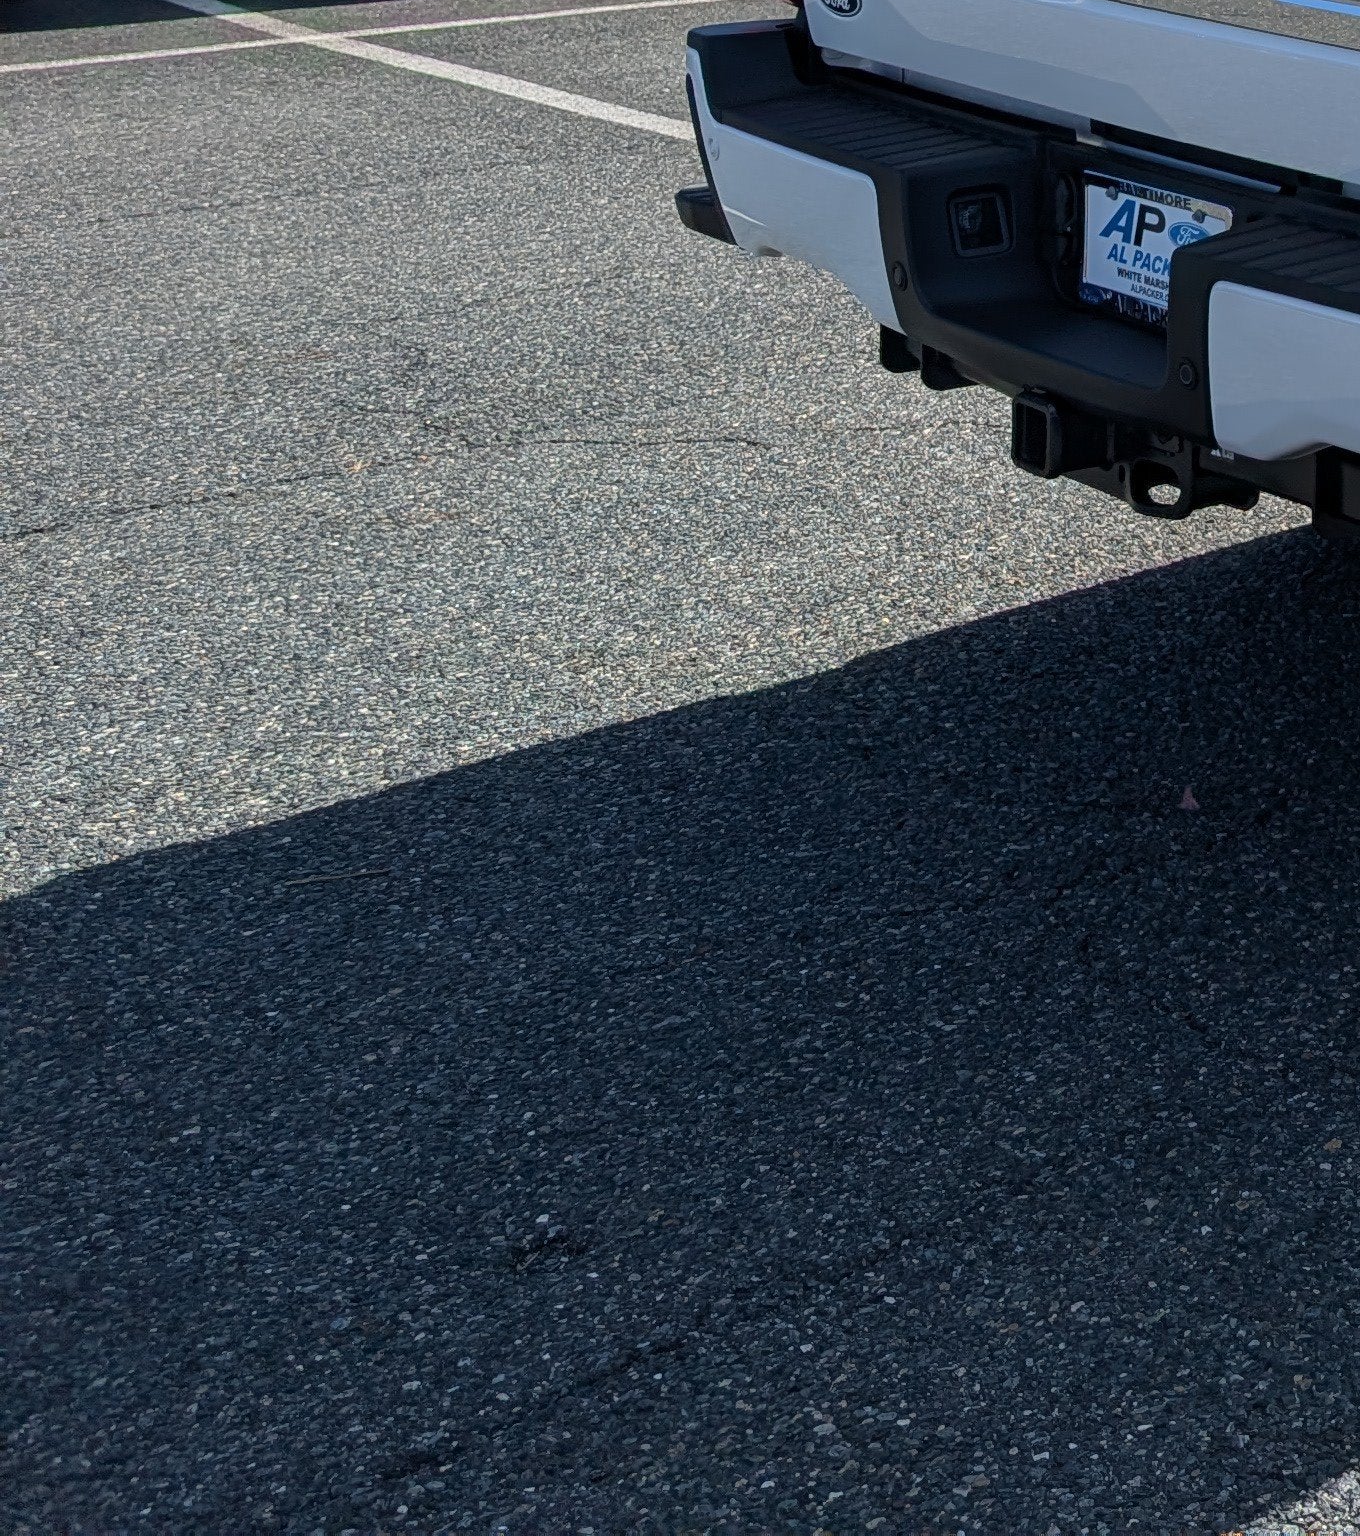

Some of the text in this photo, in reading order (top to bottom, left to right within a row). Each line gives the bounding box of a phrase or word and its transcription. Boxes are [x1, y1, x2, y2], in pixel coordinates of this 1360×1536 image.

[1099, 198, 1166, 247] AP
[1107, 243, 1171, 276] AL PACK
[1117, 267, 1142, 284] WHITE
[1130, 282, 1169, 303] ALPACKER.C
